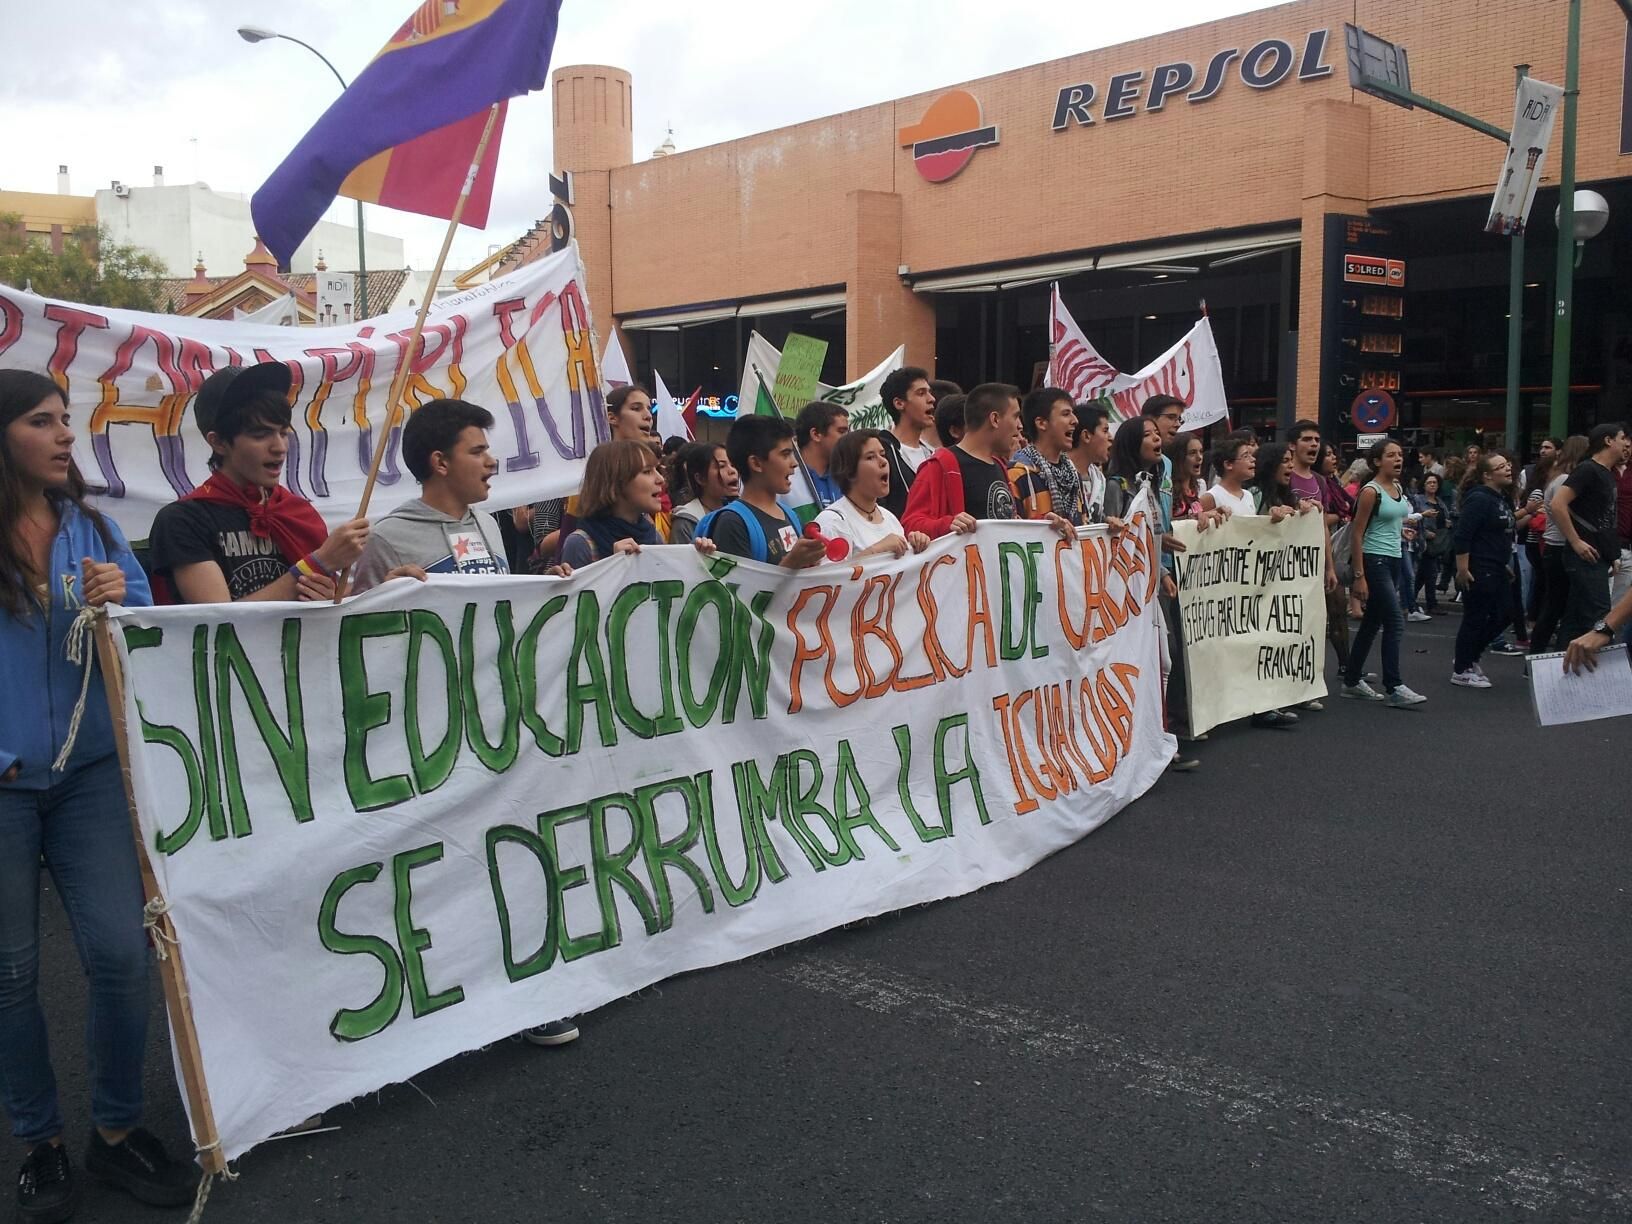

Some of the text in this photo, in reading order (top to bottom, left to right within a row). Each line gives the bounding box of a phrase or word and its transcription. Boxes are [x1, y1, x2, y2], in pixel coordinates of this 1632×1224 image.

[1051, 27, 1334, 132] REPSOL
[1348, 263, 1385, 277] SOLRED
[61, 574, 81, 610] K
[1217, 593, 1264, 637] PARLENT
[122, 618, 314, 856] SIN
[338, 557, 775, 812] EDUCACIÓN
[787, 544, 998, 715] PÚBLICA
[999, 541, 1049, 660] DE
[317, 842, 465, 1042] SE
[485, 739, 902, 983] DERRUMBA
[892, 712, 992, 843] LA
